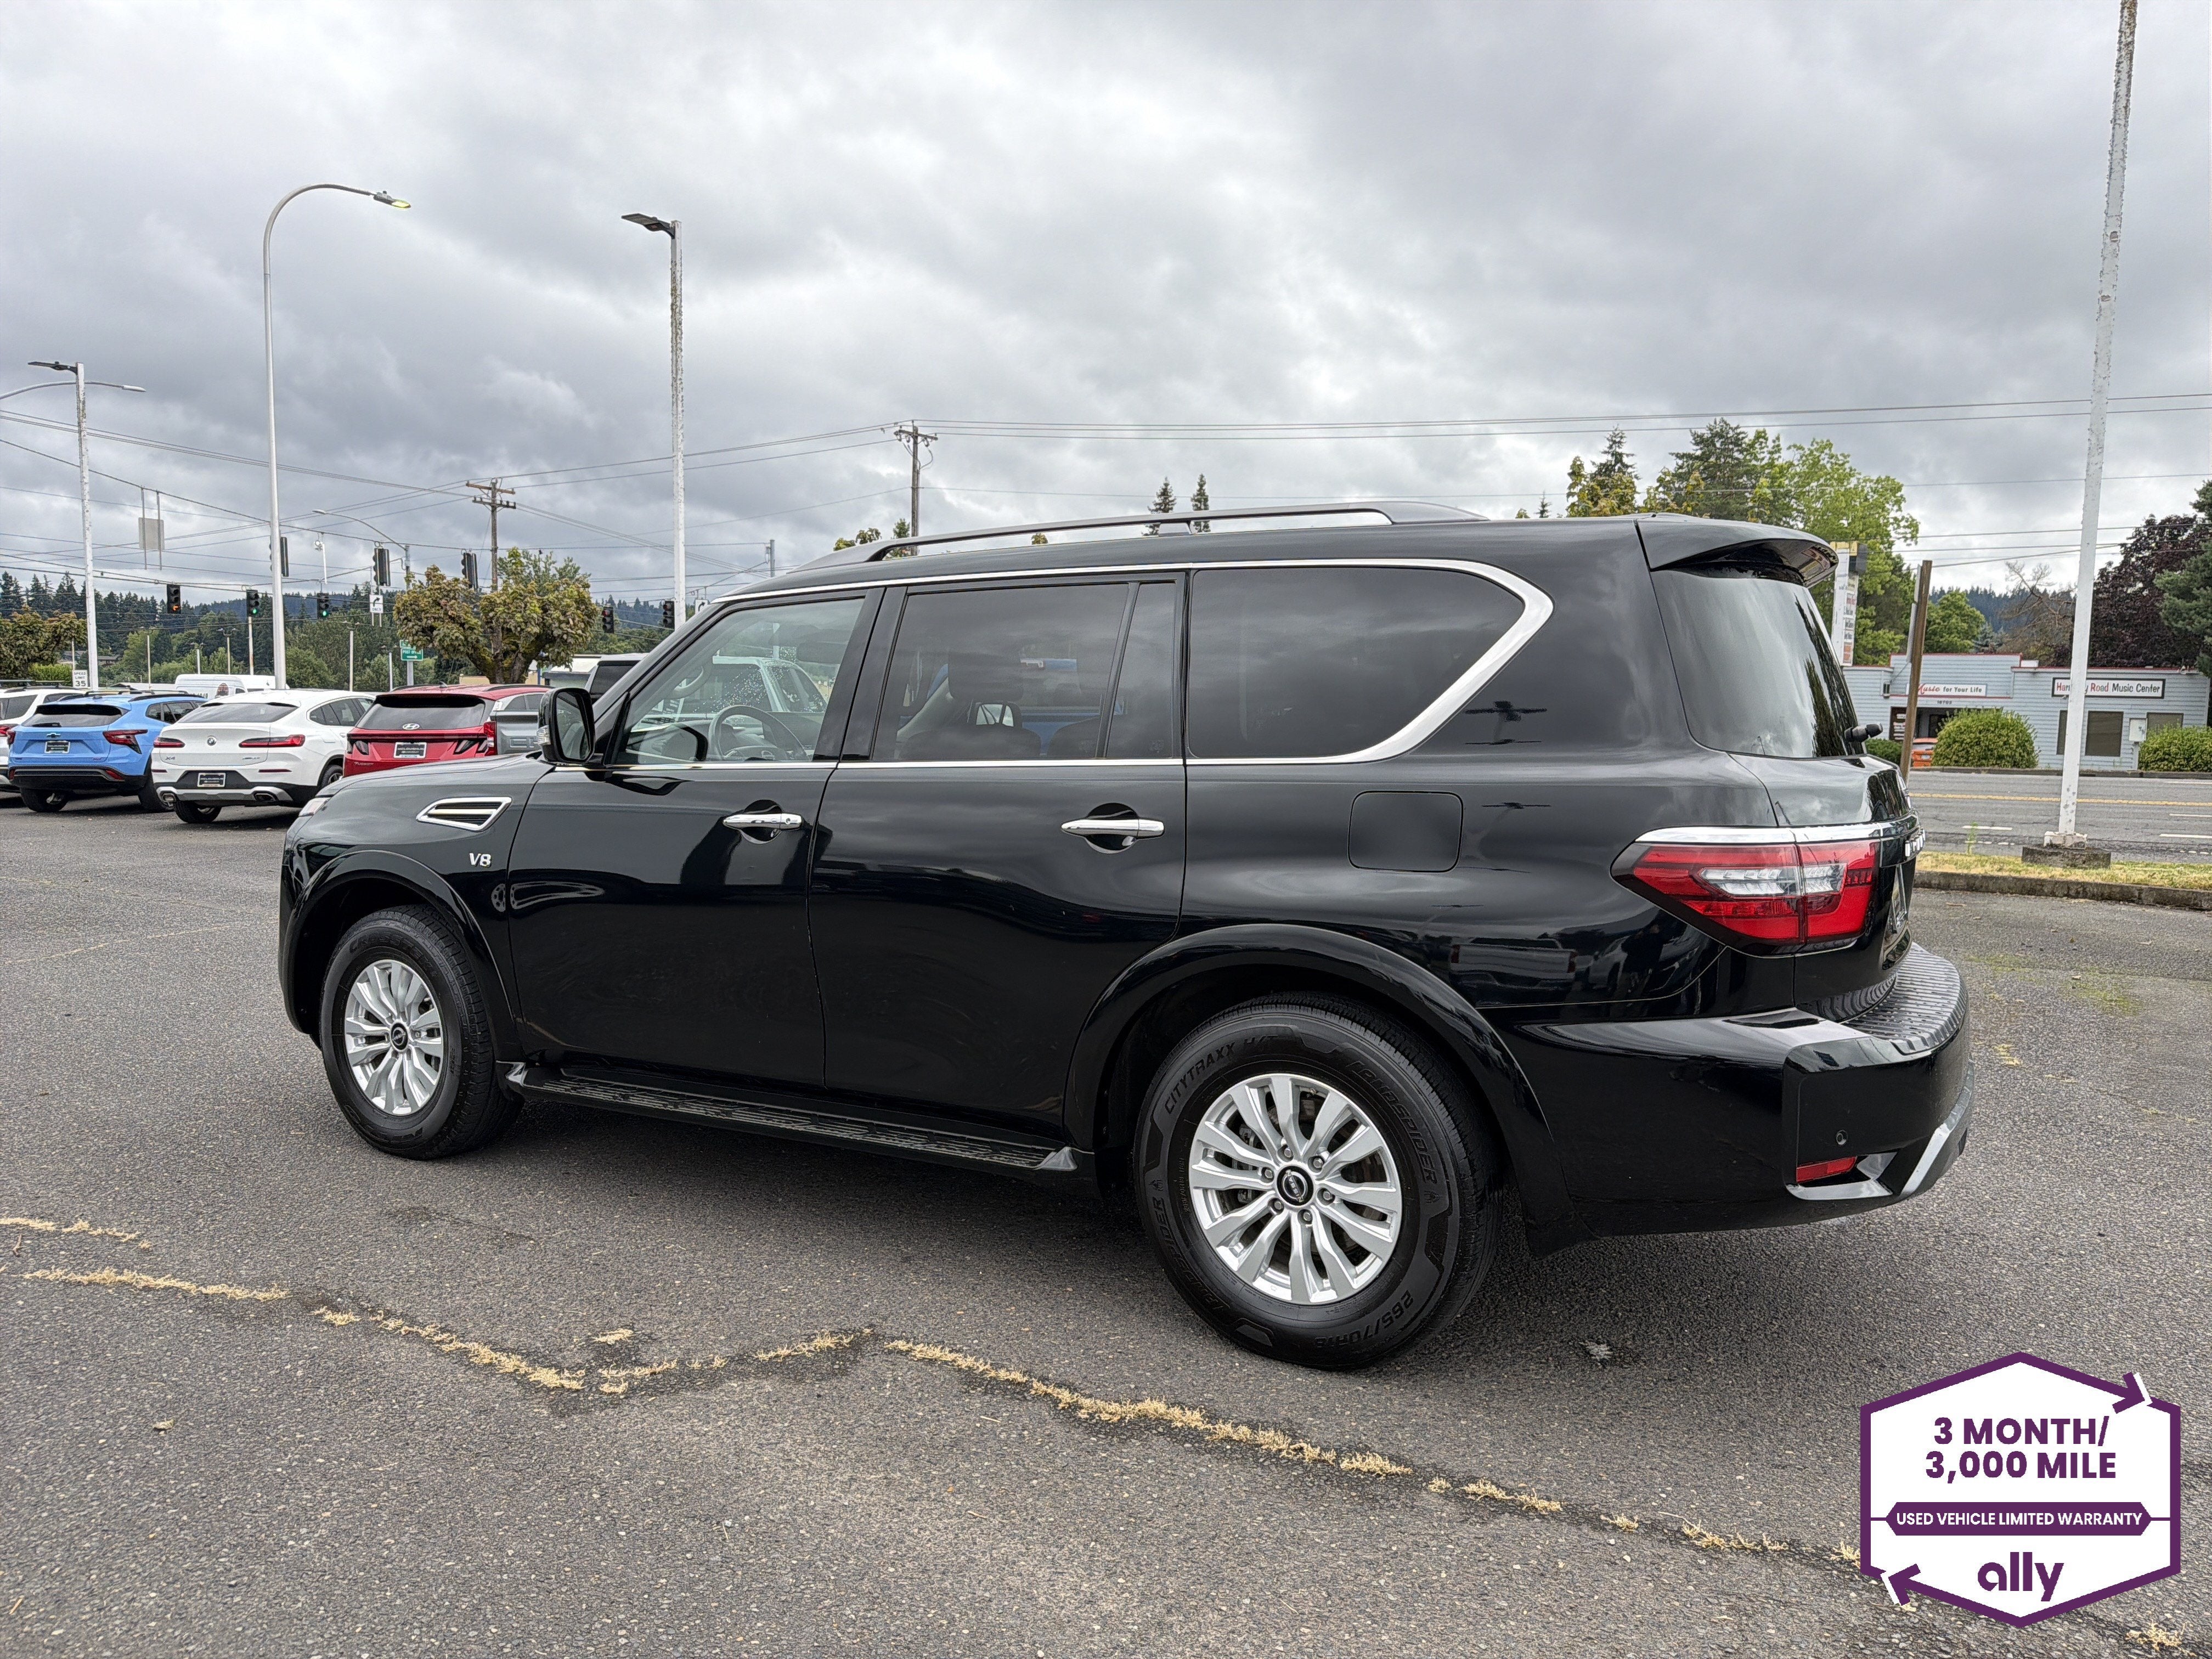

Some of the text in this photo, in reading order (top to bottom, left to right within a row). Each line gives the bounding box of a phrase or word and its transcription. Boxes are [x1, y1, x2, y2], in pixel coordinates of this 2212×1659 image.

[2056, 682, 2160, 695] Hary Road Music Center
[469, 853, 492, 867] V8
[1164, 1041, 1235, 1115] CITYTRAXX
